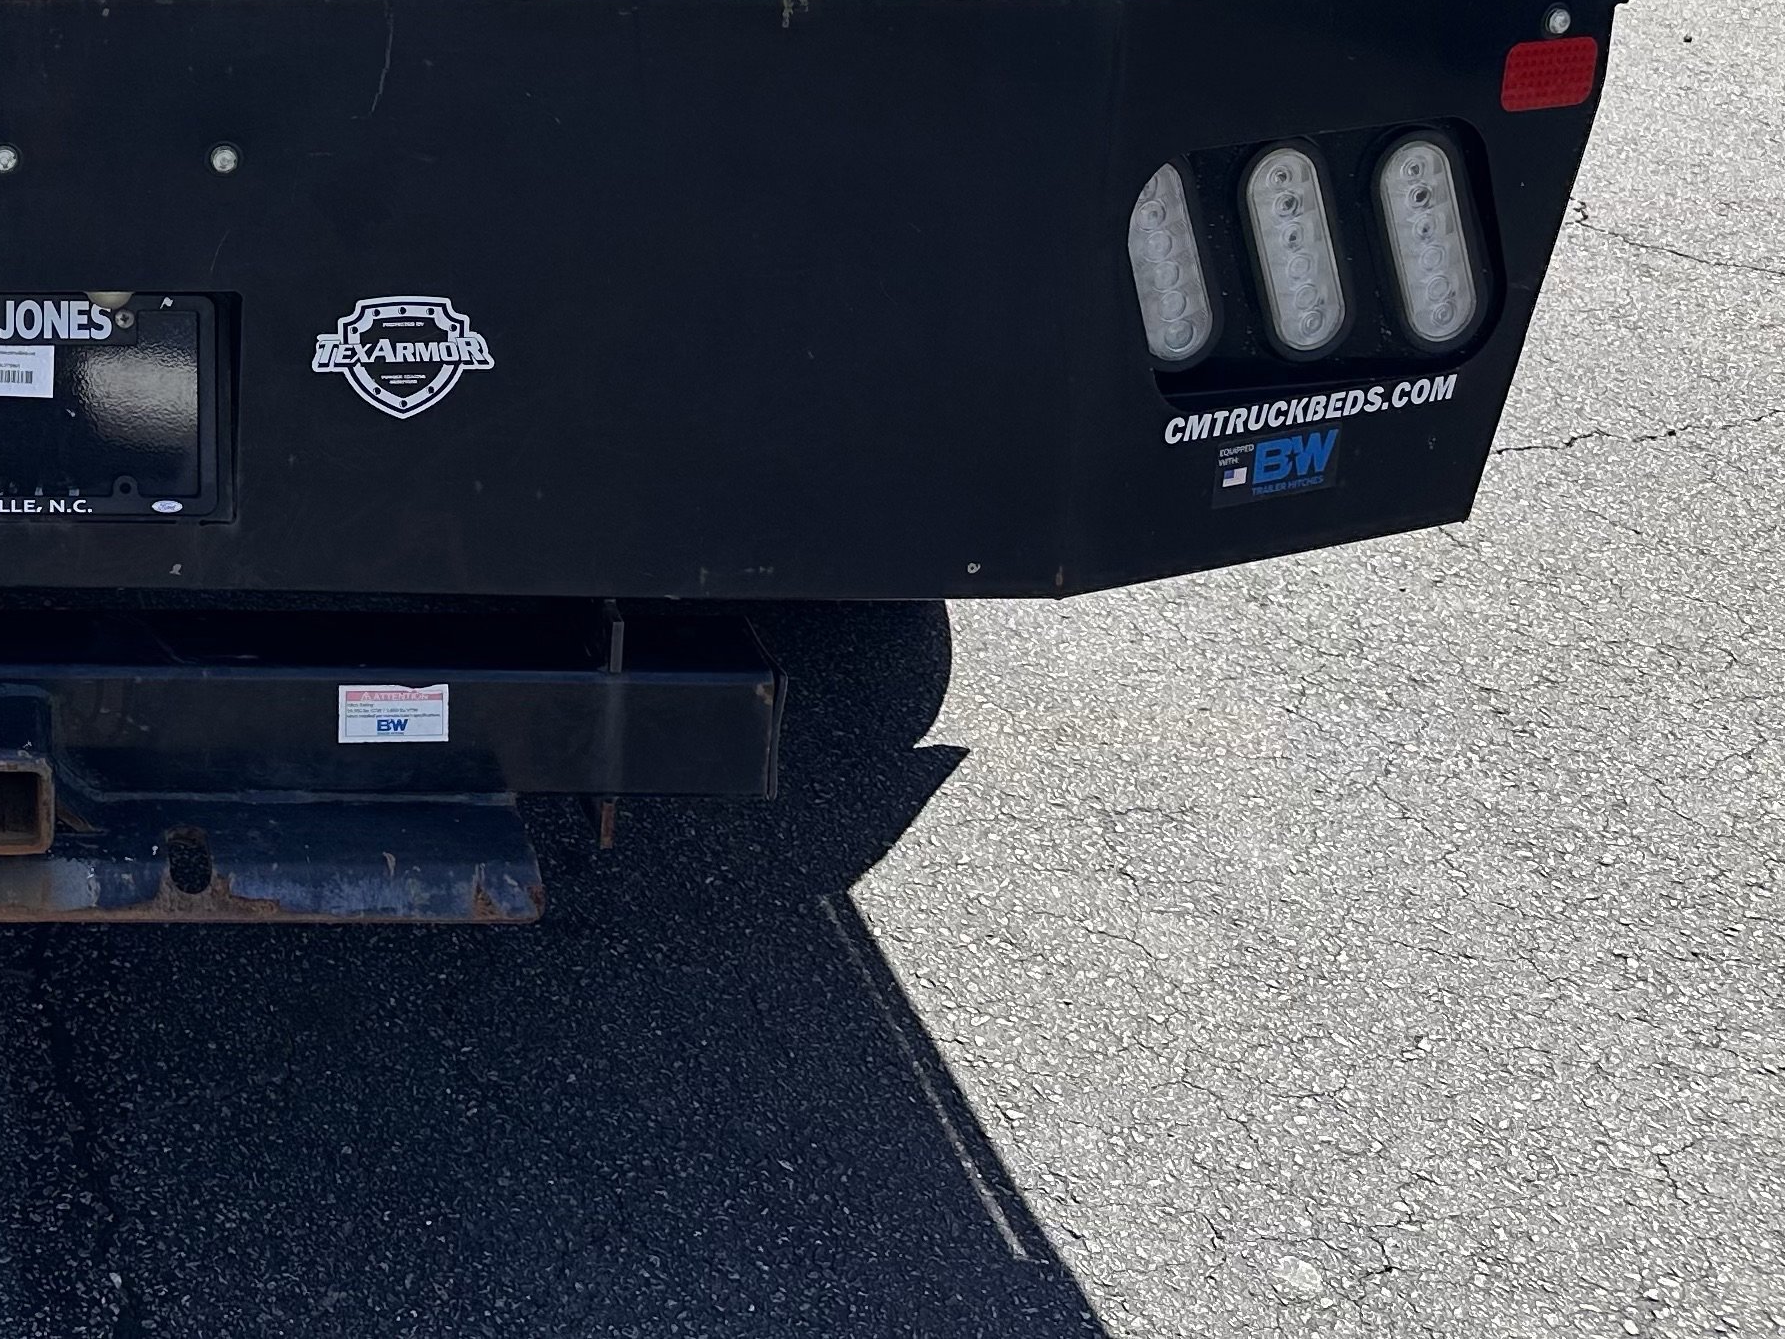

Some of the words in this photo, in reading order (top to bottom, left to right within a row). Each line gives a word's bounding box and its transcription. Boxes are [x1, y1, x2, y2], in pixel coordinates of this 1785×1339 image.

[0, 299, 113, 340] JONES
[1164, 373, 1458, 445] CMTRUCKBEDS.COM
[49, 499, 94, 513] N.C.
[373, 691, 430, 701] ATTENTION
